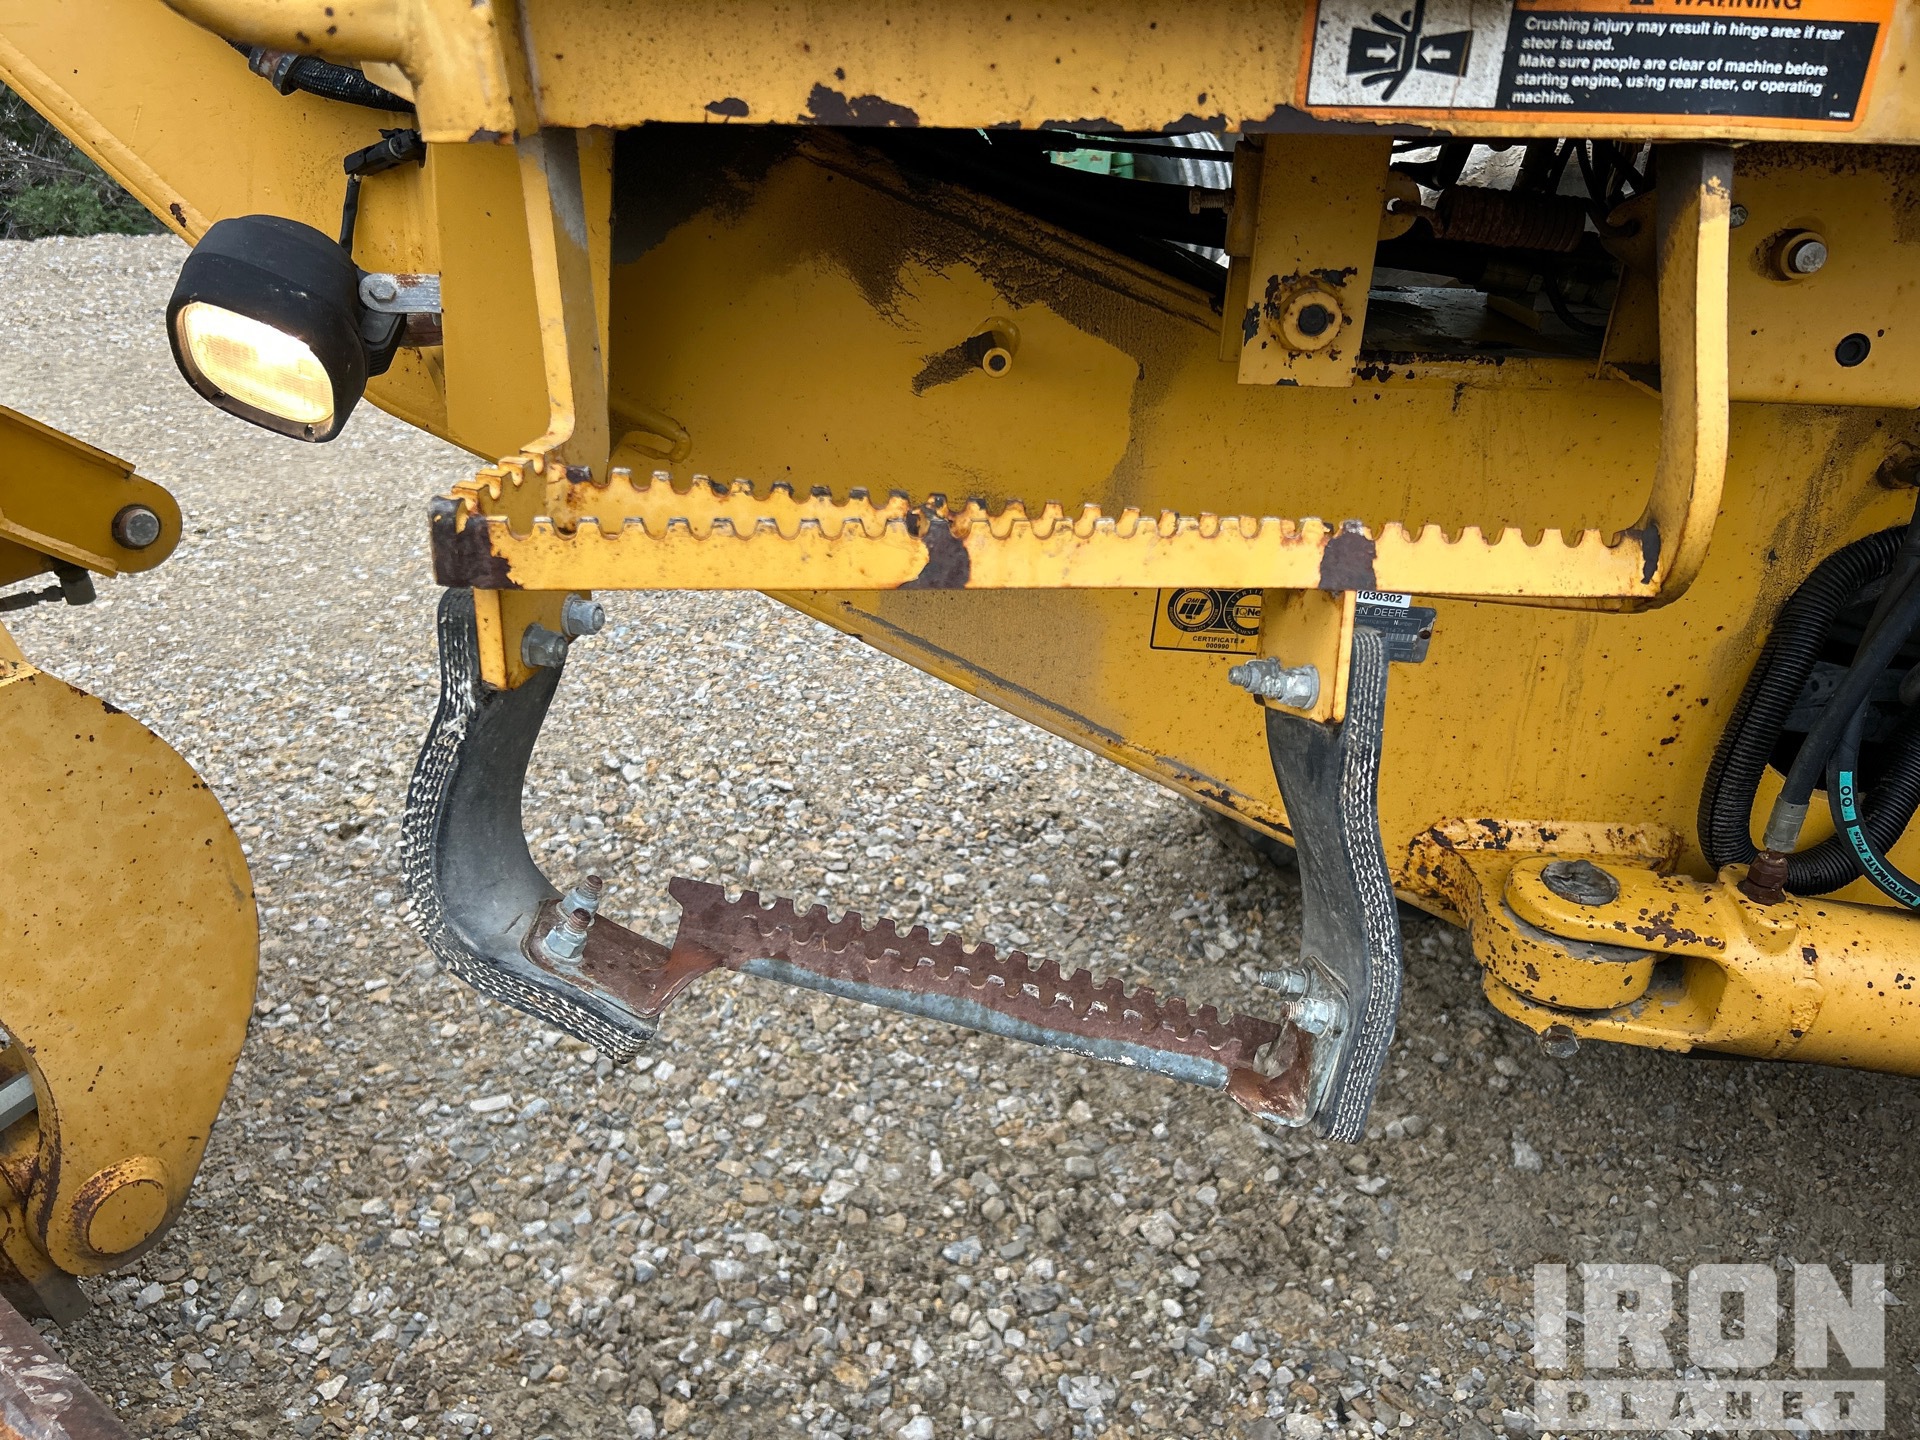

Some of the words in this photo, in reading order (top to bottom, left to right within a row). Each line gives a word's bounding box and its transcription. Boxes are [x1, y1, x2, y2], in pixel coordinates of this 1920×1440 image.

[1525, 15, 1590, 35] Crushing
[1593, 17, 1634, 36] injury
[1636, 21, 1667, 37] may
[1670, 21, 1710, 35] result
[1713, 21, 1727, 34] in
[1729, 22, 1769, 40] hinge
[1771, 27, 1802, 39] area
[1804, 24, 1815, 40] if
[1815, 28, 1845, 41] rear
[1560, 35, 1574, 50] is
[1577, 36, 1615, 51] used.
[1518, 53, 1556, 68] Make
[1558, 56, 1590, 69] sure
[1592, 55, 1640, 73] people
[1643, 58, 1666, 71] are
[1669, 57, 1705, 71] clear
[1707, 57, 1723, 72] of
[1725, 59, 1782, 75] machine
[1784, 61, 1828, 77] before
[1515, 72, 1569, 88] starting
[1571, 73, 1623, 90] engine,
[1626, 75, 1666, 91] using
[1669, 77, 1698, 89] rear
[1700, 76, 1739, 93] steer,
[1742, 80, 1758, 92] or
[1760, 79, 1823, 97] operating
[1512, 90, 1575, 105] machine.
[1357, 590, 1403, 604] 1030302
[1235, 607, 1261, 618] IQNe
[1355, 606, 1369, 615] HN
[1374, 607, 1409, 618] DEERE
[1192, 635, 1239, 644] CERTIFICATE
[1205, 642, 1230, 650] 000990
[1853, 831, 1869, 854] Plus
[1863, 855, 1918, 904] MATCHMATE
